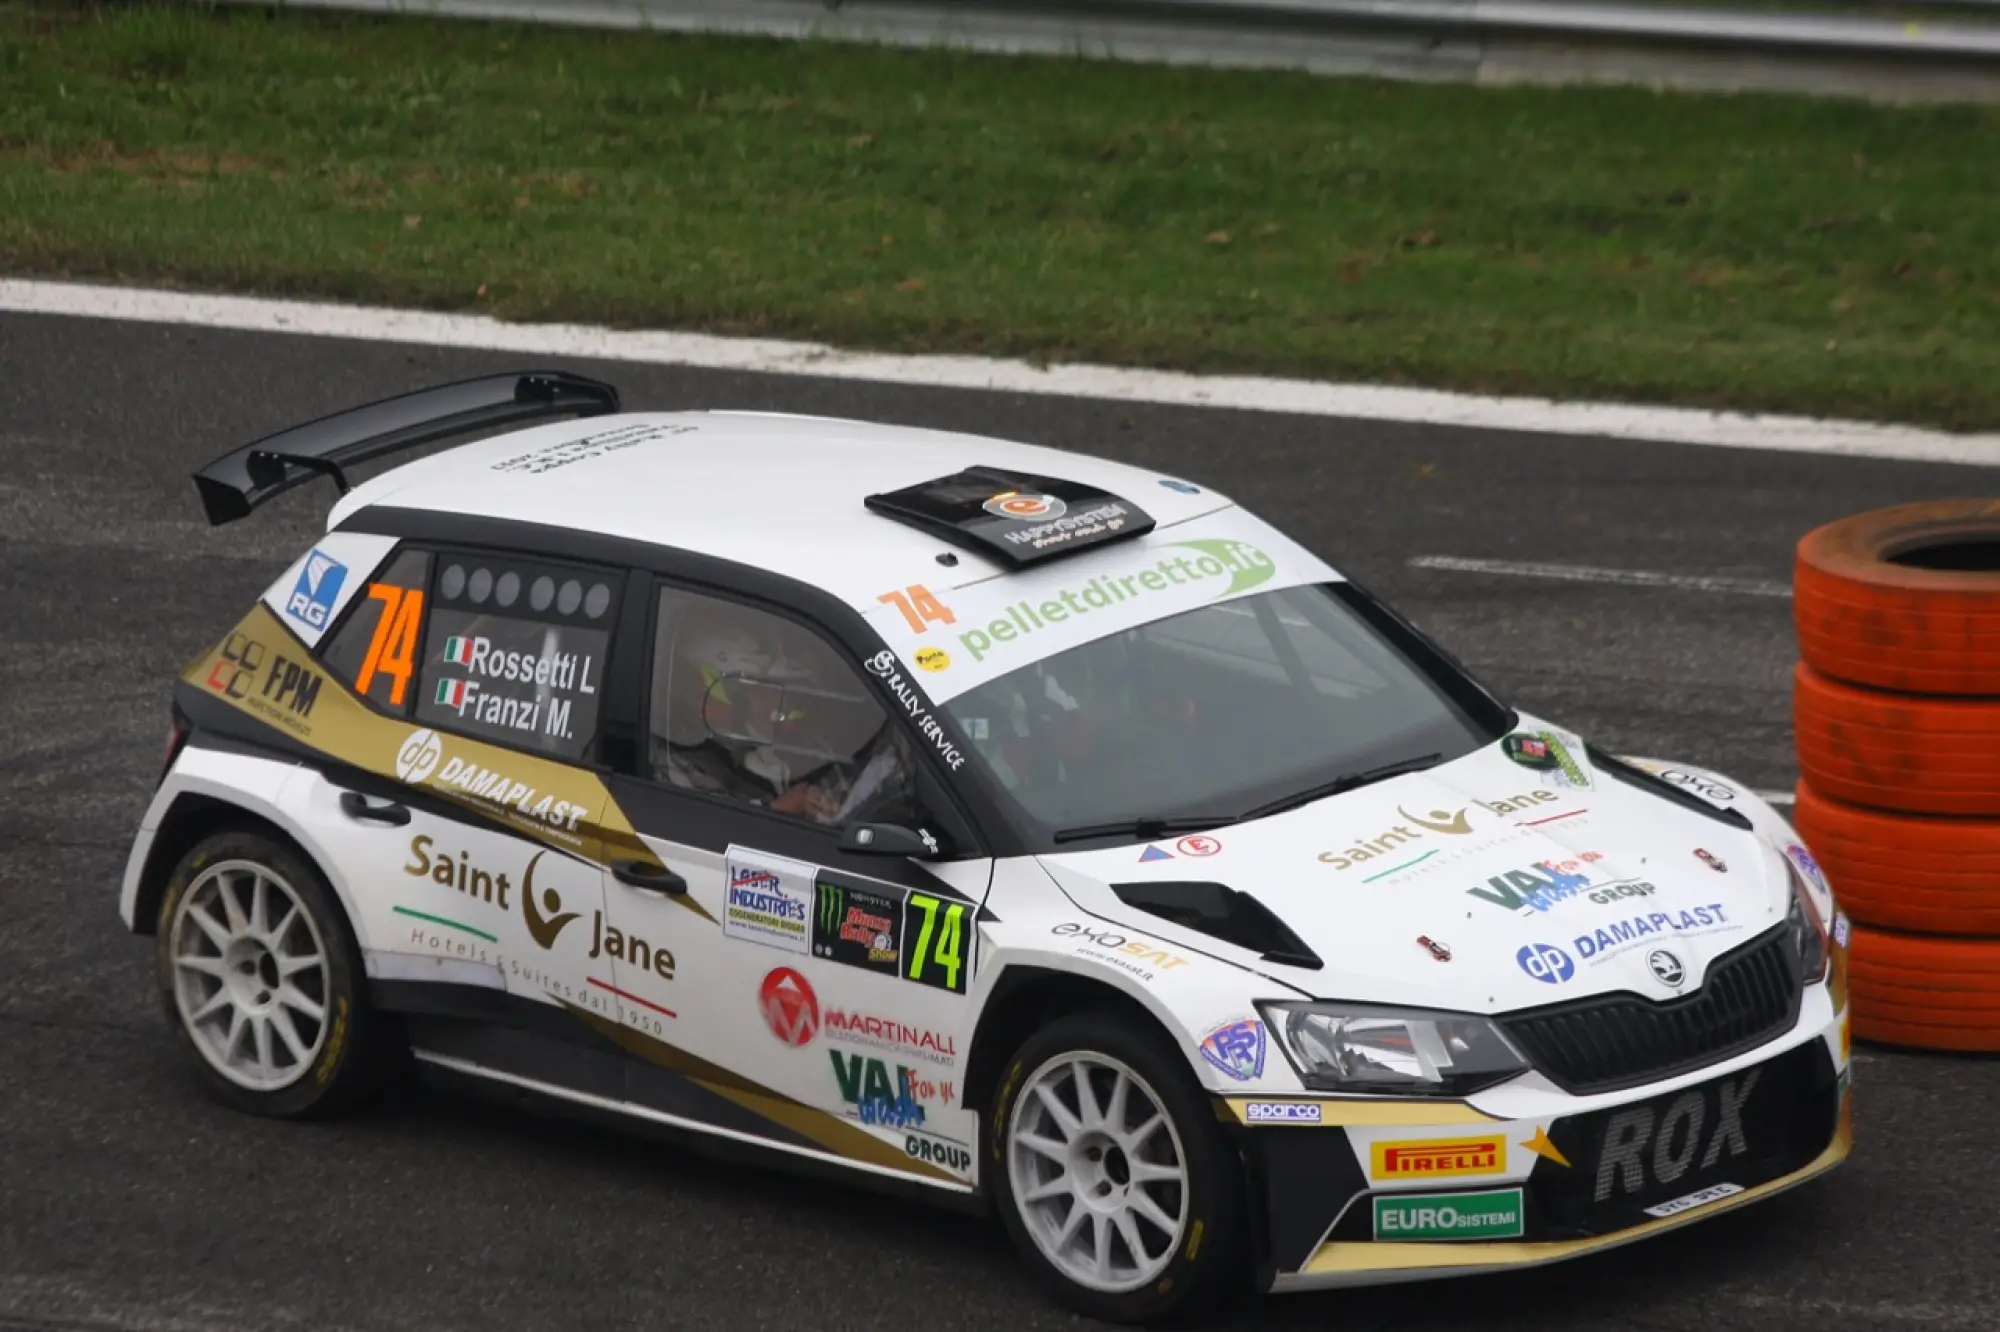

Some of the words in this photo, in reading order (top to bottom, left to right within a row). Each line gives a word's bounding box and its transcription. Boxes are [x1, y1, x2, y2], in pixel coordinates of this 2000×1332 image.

[289, 592, 328, 627] RG
[877, 583, 957, 634] 74
[958, 540, 1270, 662] pelletdiretto.it
[354, 582, 424, 705] 74
[468, 636, 578, 692] Rossetti
[579, 655, 595, 695] L
[264, 656, 323, 717] FPM
[458, 680, 542, 732] Franzi
[545, 697, 573, 740] M.
[887, 674, 926, 717] RALLY
[918, 714, 965, 772] SERVICE
[438, 756, 589, 831] DAMAPLAST
[1317, 824, 1422, 871] Saint
[1471, 788, 1558, 818] Jane
[404, 834, 511, 911] Saint
[588, 909, 676, 981] Jane
[729, 887, 806, 921] INDUSTRIES
[1588, 881, 1657, 905] GROUP
[910, 894, 965, 989] 74
[1573, 903, 1728, 959] DAMAPLAST
[411, 928, 487, 963] Hotels
[511, 960, 572, 998] Suites
[578, 986, 608, 1012] dal
[1247, 1103, 1321, 1121] sparco
[1594, 1069, 1762, 1202] ROX
[905, 1135, 971, 1172] GROUP
[1385, 1142, 1496, 1173] PIRELLI
[1381, 1204, 1516, 1232] EUROSISTEMI
